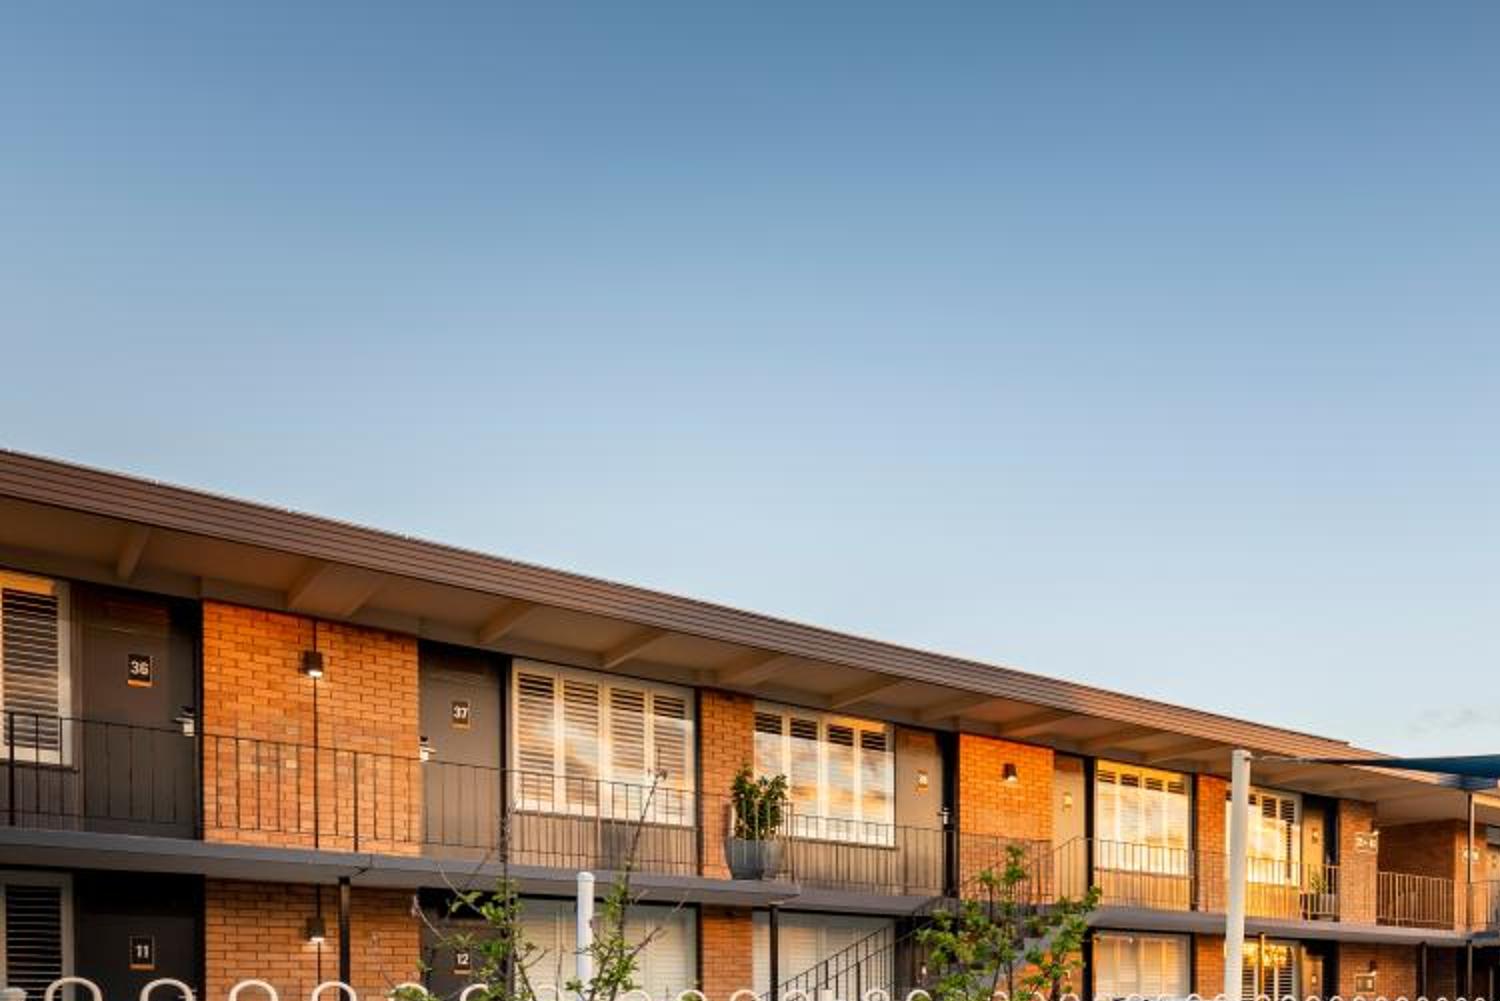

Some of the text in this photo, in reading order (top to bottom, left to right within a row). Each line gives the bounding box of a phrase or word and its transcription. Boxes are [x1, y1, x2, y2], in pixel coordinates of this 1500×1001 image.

[130, 660, 149, 675] 36
[453, 705, 469, 719] 37
[135, 945, 150, 959] 11
[456, 953, 470, 965] 12
